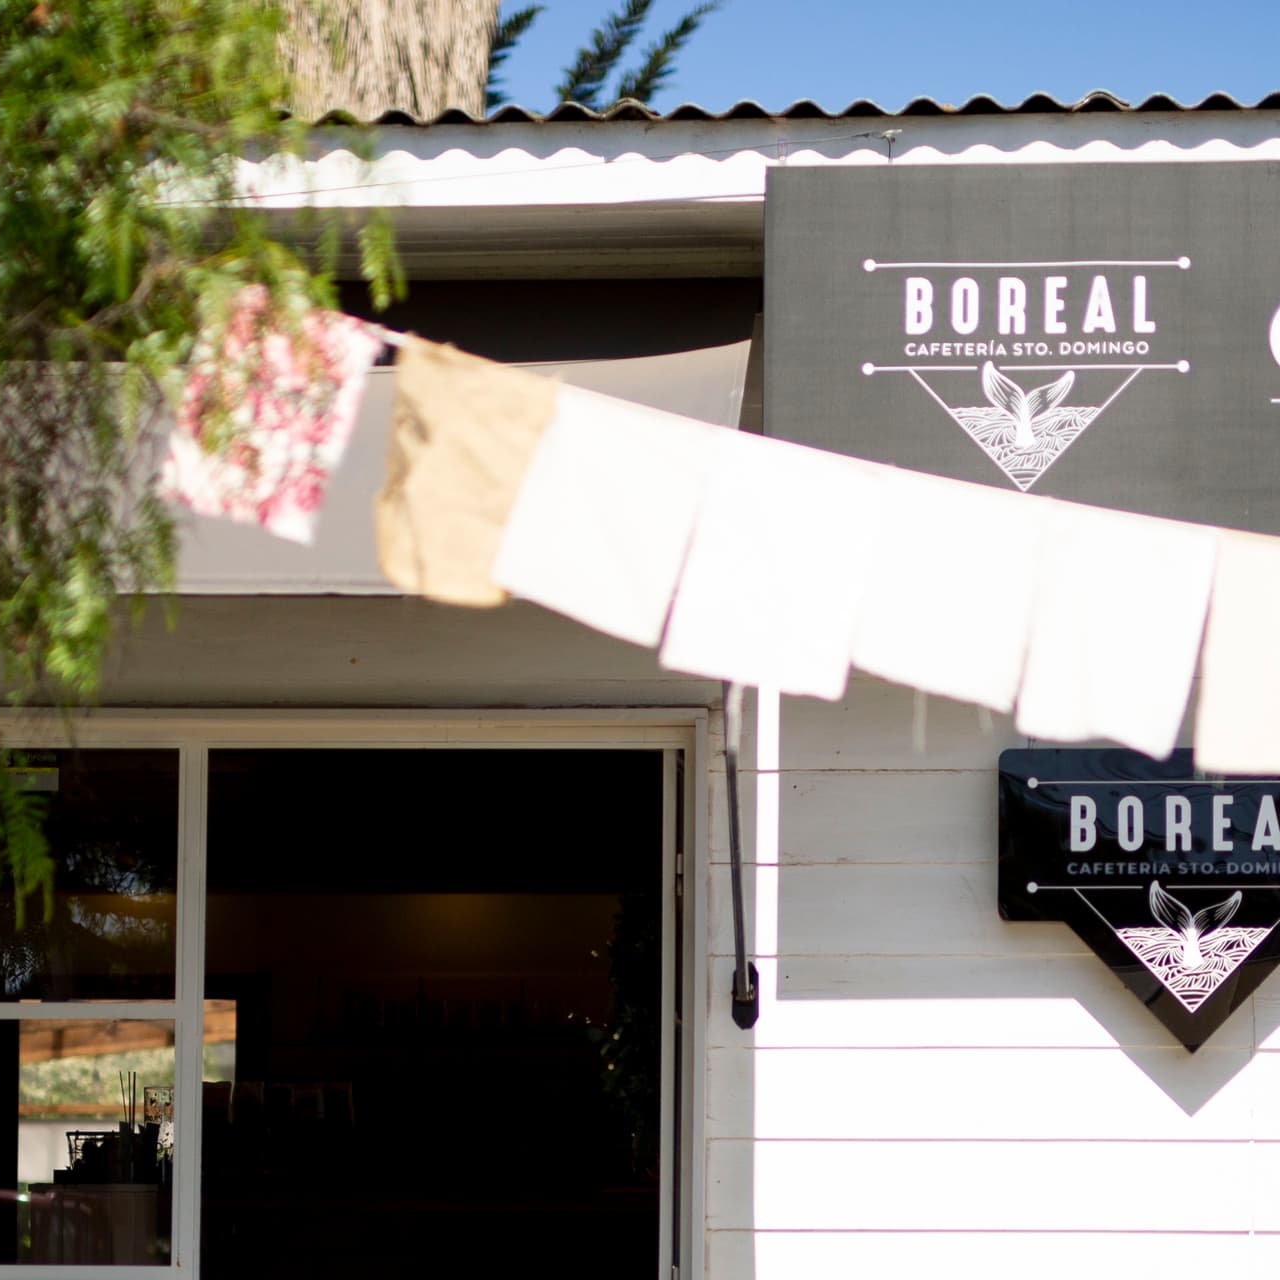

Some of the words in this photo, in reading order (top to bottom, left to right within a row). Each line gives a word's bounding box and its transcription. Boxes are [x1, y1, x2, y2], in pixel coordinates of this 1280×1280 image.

[904, 274, 1157, 335] BOREAL
[904, 339, 1008, 357] CAFETERÍA
[1012, 341, 1053, 357] STO.
[1059, 340, 1150, 356] DOMINGO
[1177, 860, 1221, 876] STO.
